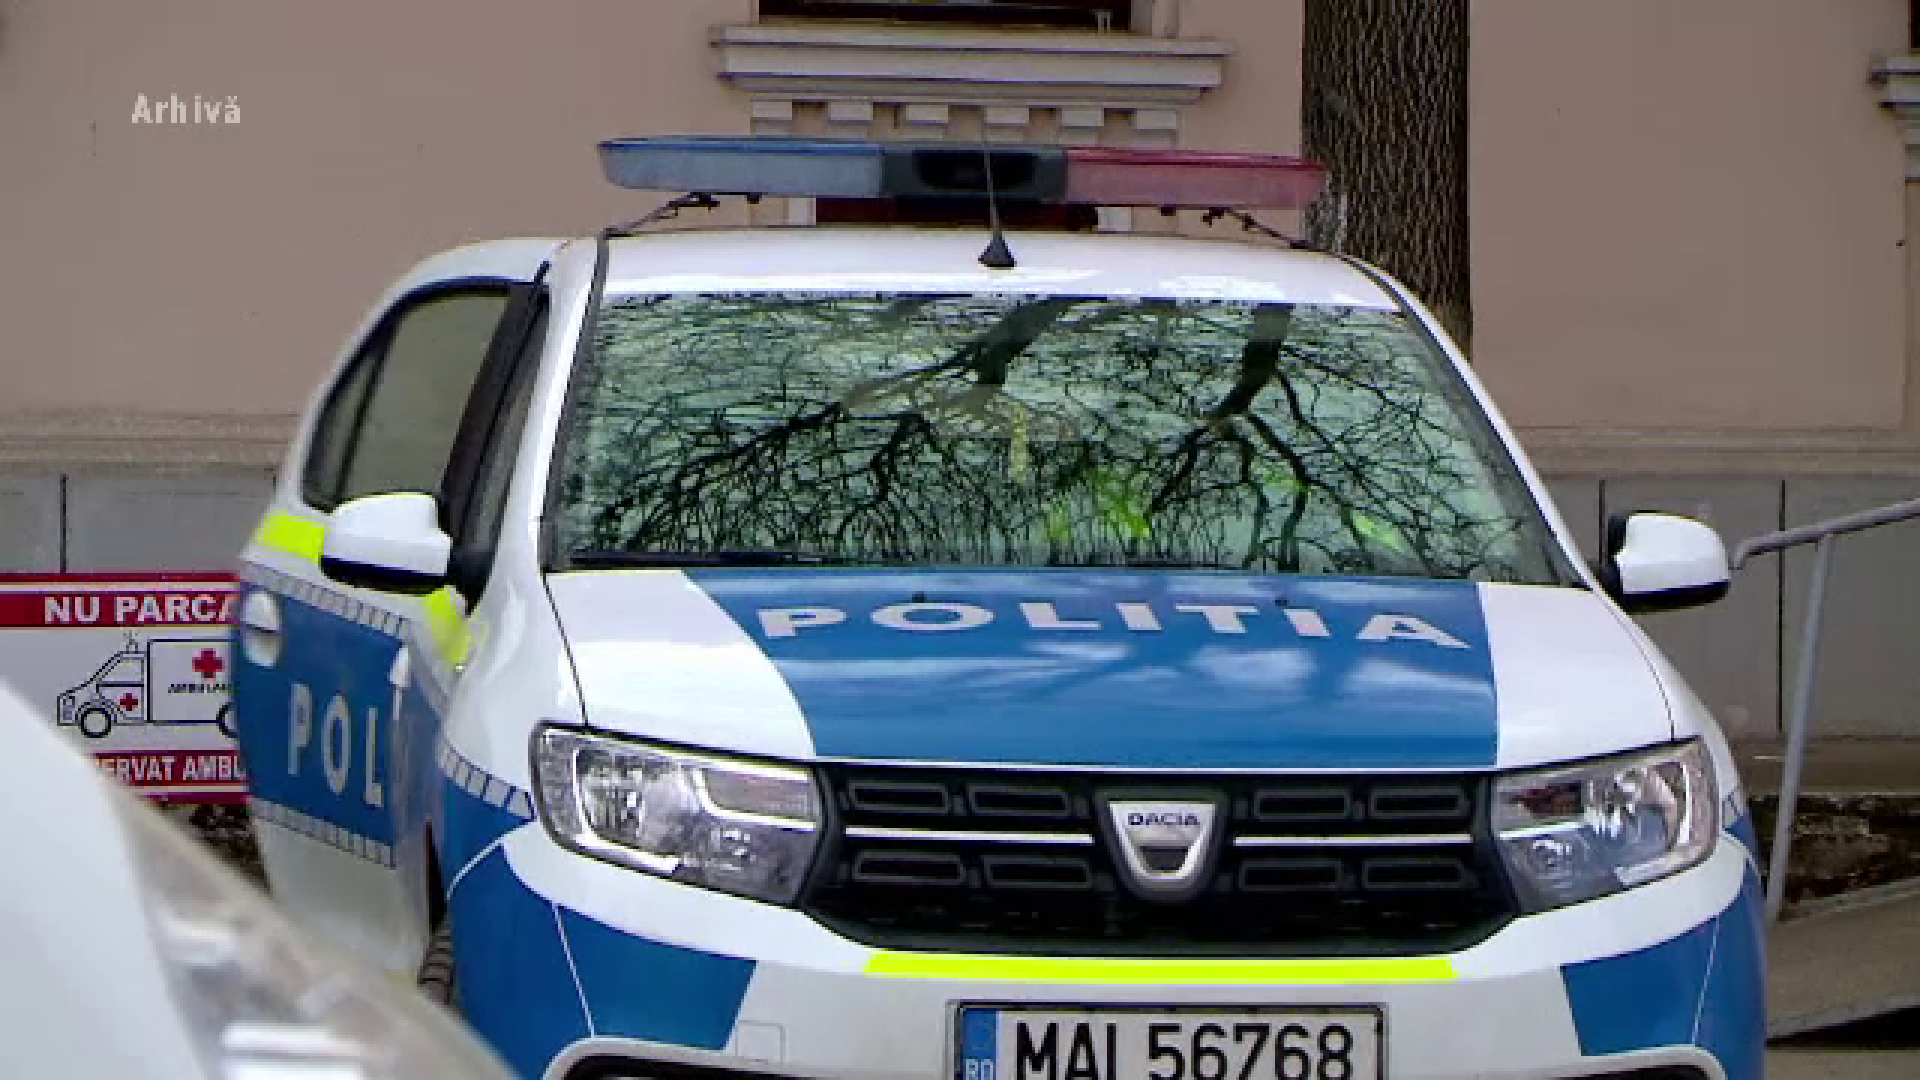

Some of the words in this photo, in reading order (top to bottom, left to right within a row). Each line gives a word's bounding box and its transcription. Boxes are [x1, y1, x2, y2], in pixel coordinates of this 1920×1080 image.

[44, 596, 100, 622] NU
[757, 601, 1472, 648] POLITIA
[1127, 812, 1201, 826] DACIA
[1016, 1022, 1117, 1080] MAI
[1148, 1022, 1354, 1080] 56768
